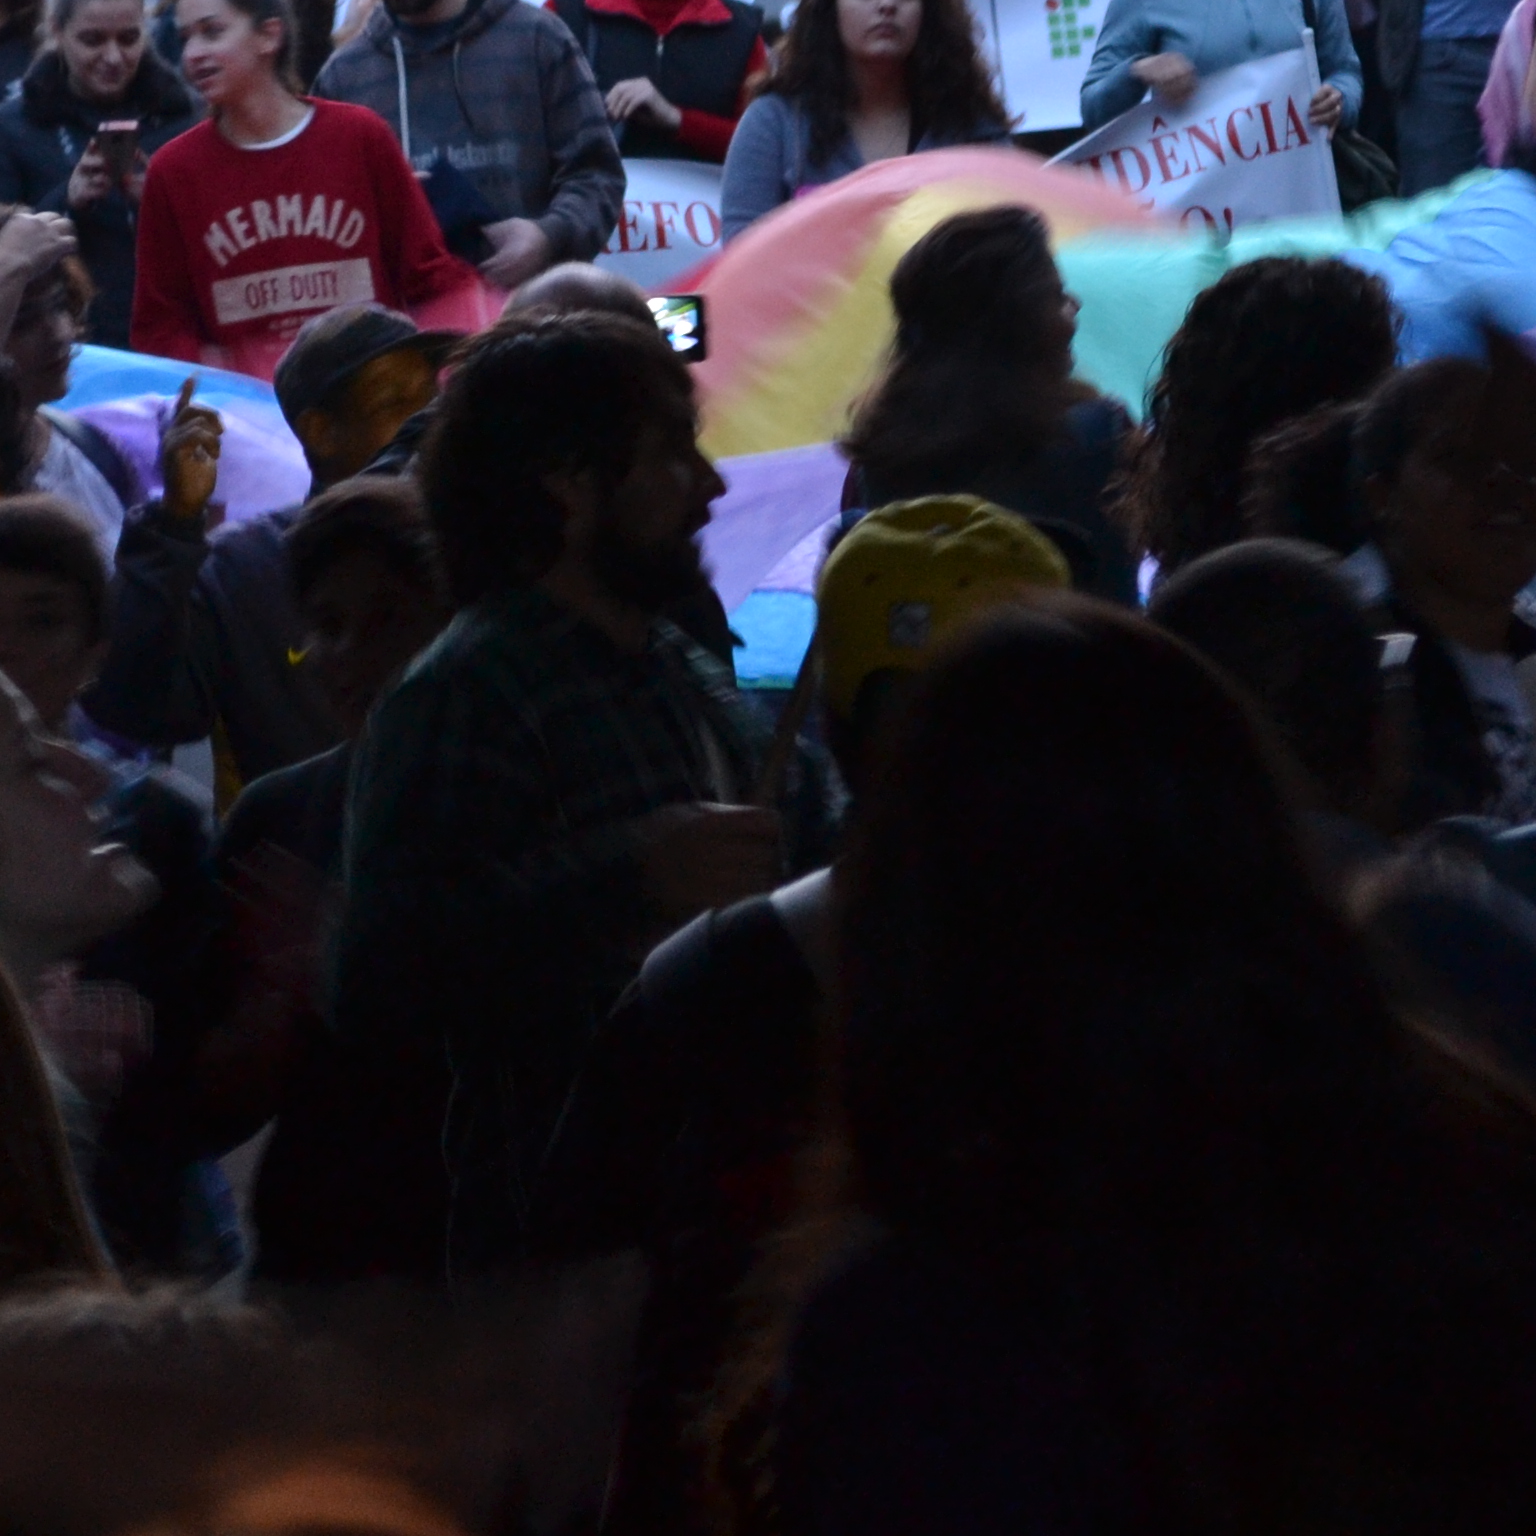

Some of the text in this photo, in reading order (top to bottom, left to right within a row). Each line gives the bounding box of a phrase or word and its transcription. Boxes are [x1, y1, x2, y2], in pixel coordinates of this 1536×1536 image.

[203, 194, 366, 268] MERMAID
[245, 270, 339, 310] OFF DUTY
